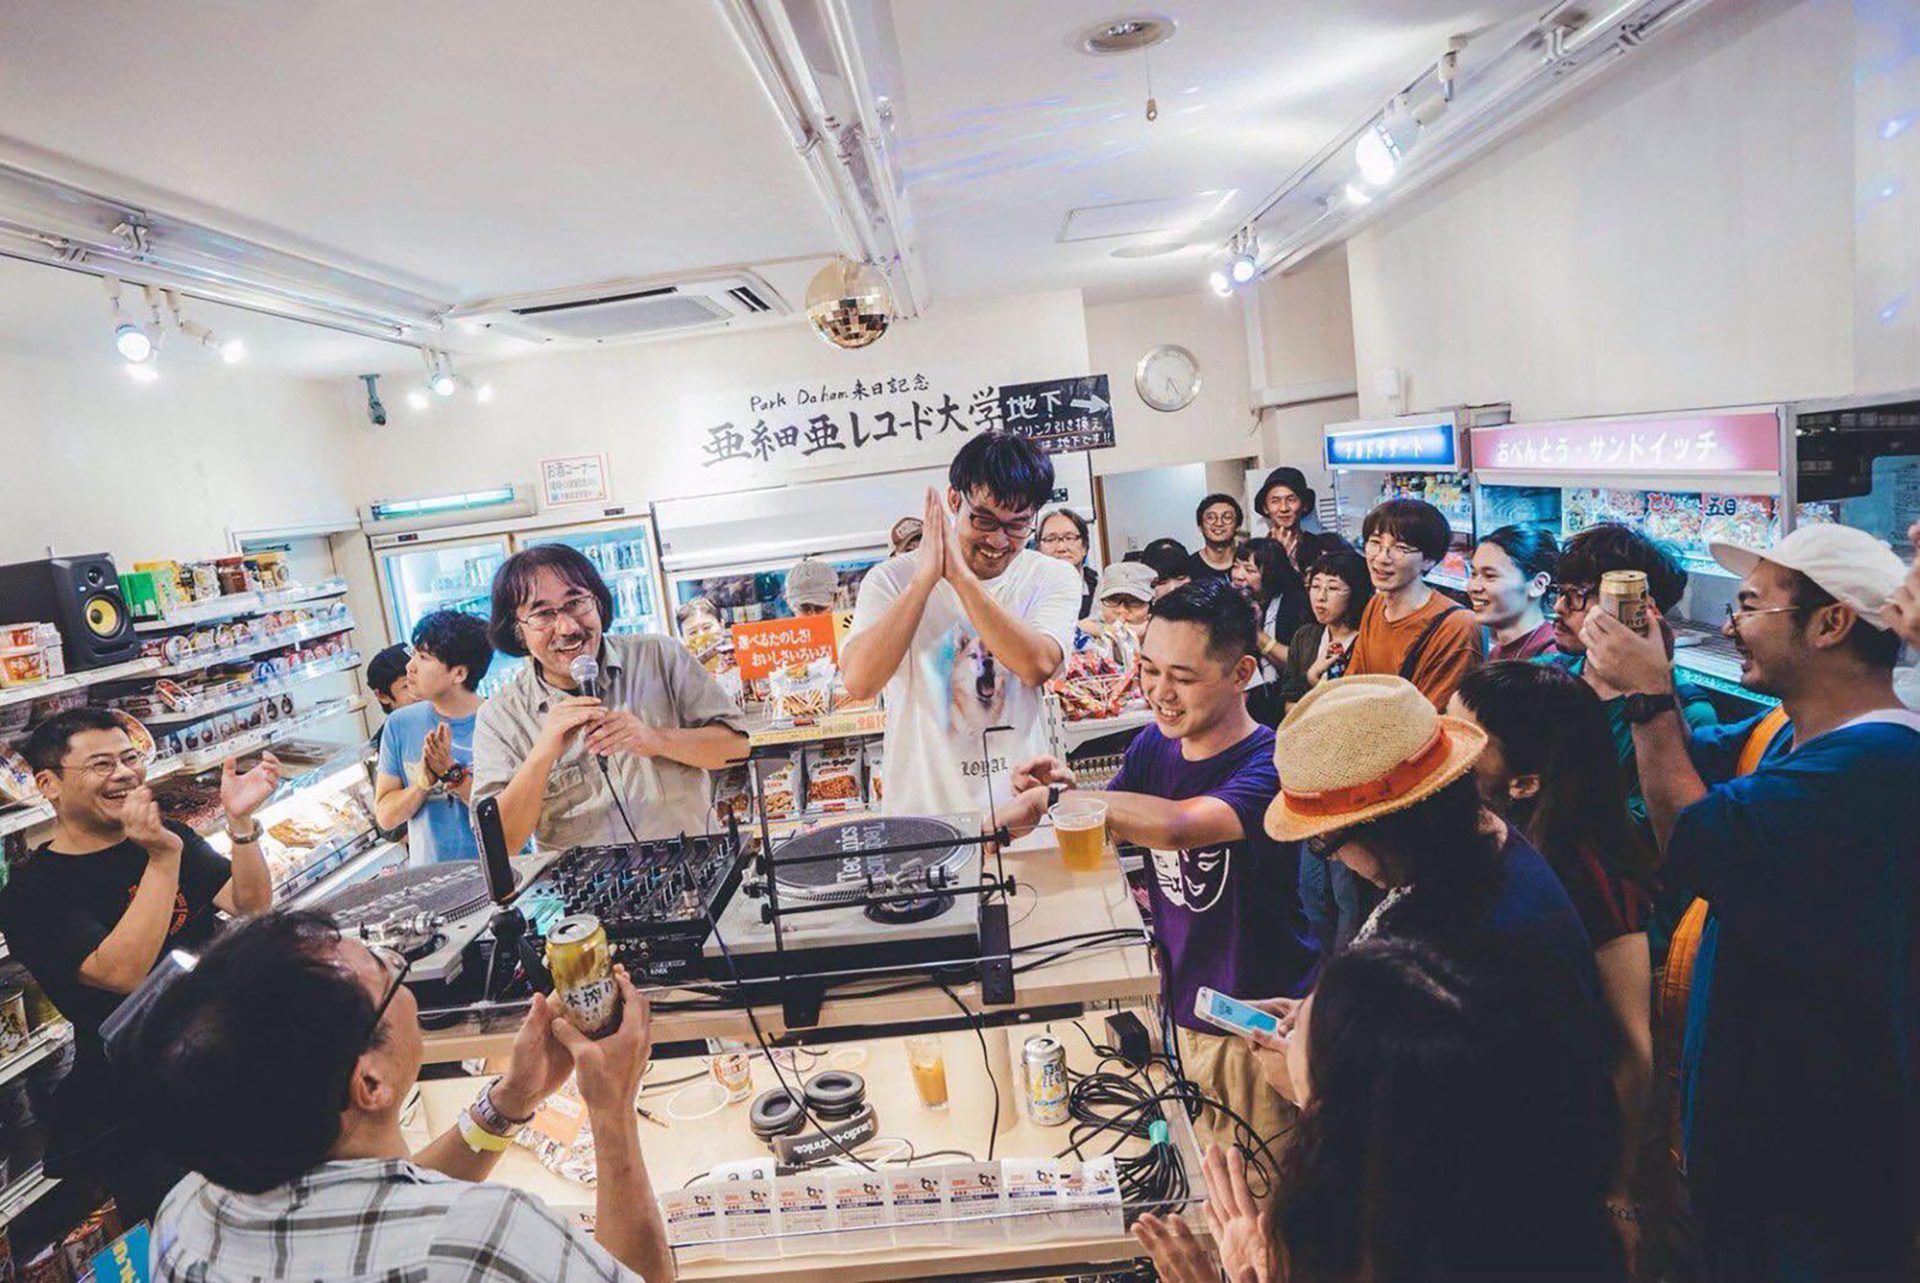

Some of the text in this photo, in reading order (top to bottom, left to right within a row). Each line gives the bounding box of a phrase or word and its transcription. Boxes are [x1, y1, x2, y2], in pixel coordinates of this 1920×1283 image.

[750, 393, 787, 412] Park
[1006, 390, 1062, 422] 地下
[702, 386, 1003, 467] 亜細亜レコード大学
[1496, 430, 1718, 464] おべんとう・サンドイッチ
[1706, 496, 1737, 517] 五目
[961, 757, 1008, 778] LOYAL
[836, 826, 862, 883] Tecnics
[863, 822, 891, 883] Techics
